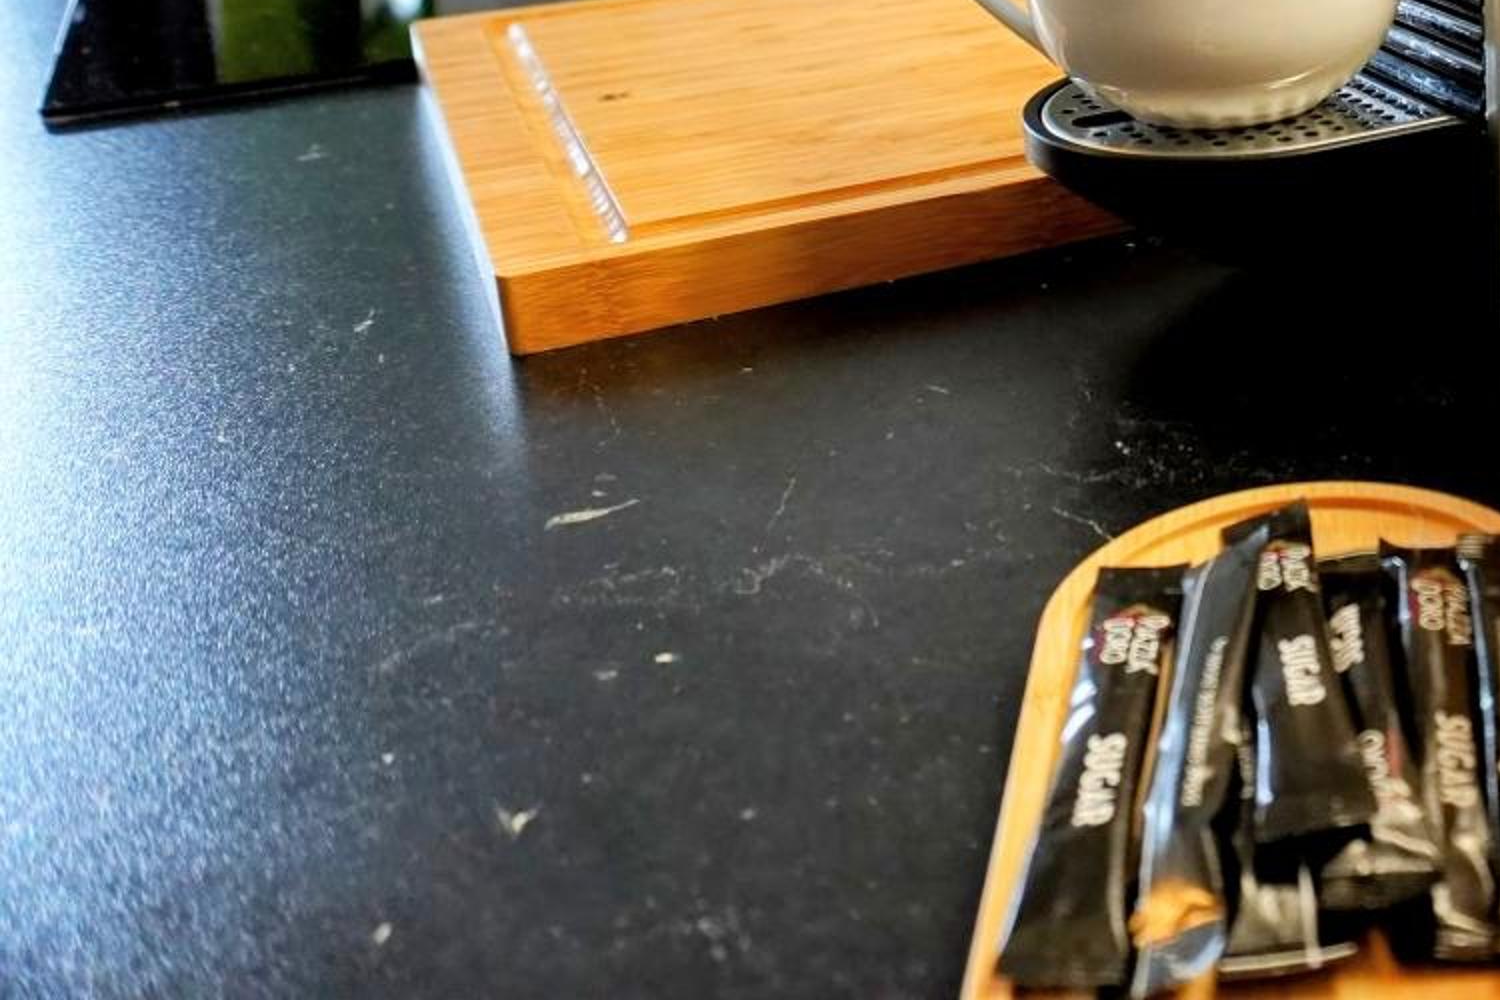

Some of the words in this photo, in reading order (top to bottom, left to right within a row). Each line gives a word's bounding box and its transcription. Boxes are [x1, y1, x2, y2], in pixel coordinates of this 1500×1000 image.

[1277, 634, 1327, 707] SUGAR
[1070, 733, 1129, 828] SUGAR
[1434, 710, 1479, 809] SUGAR
